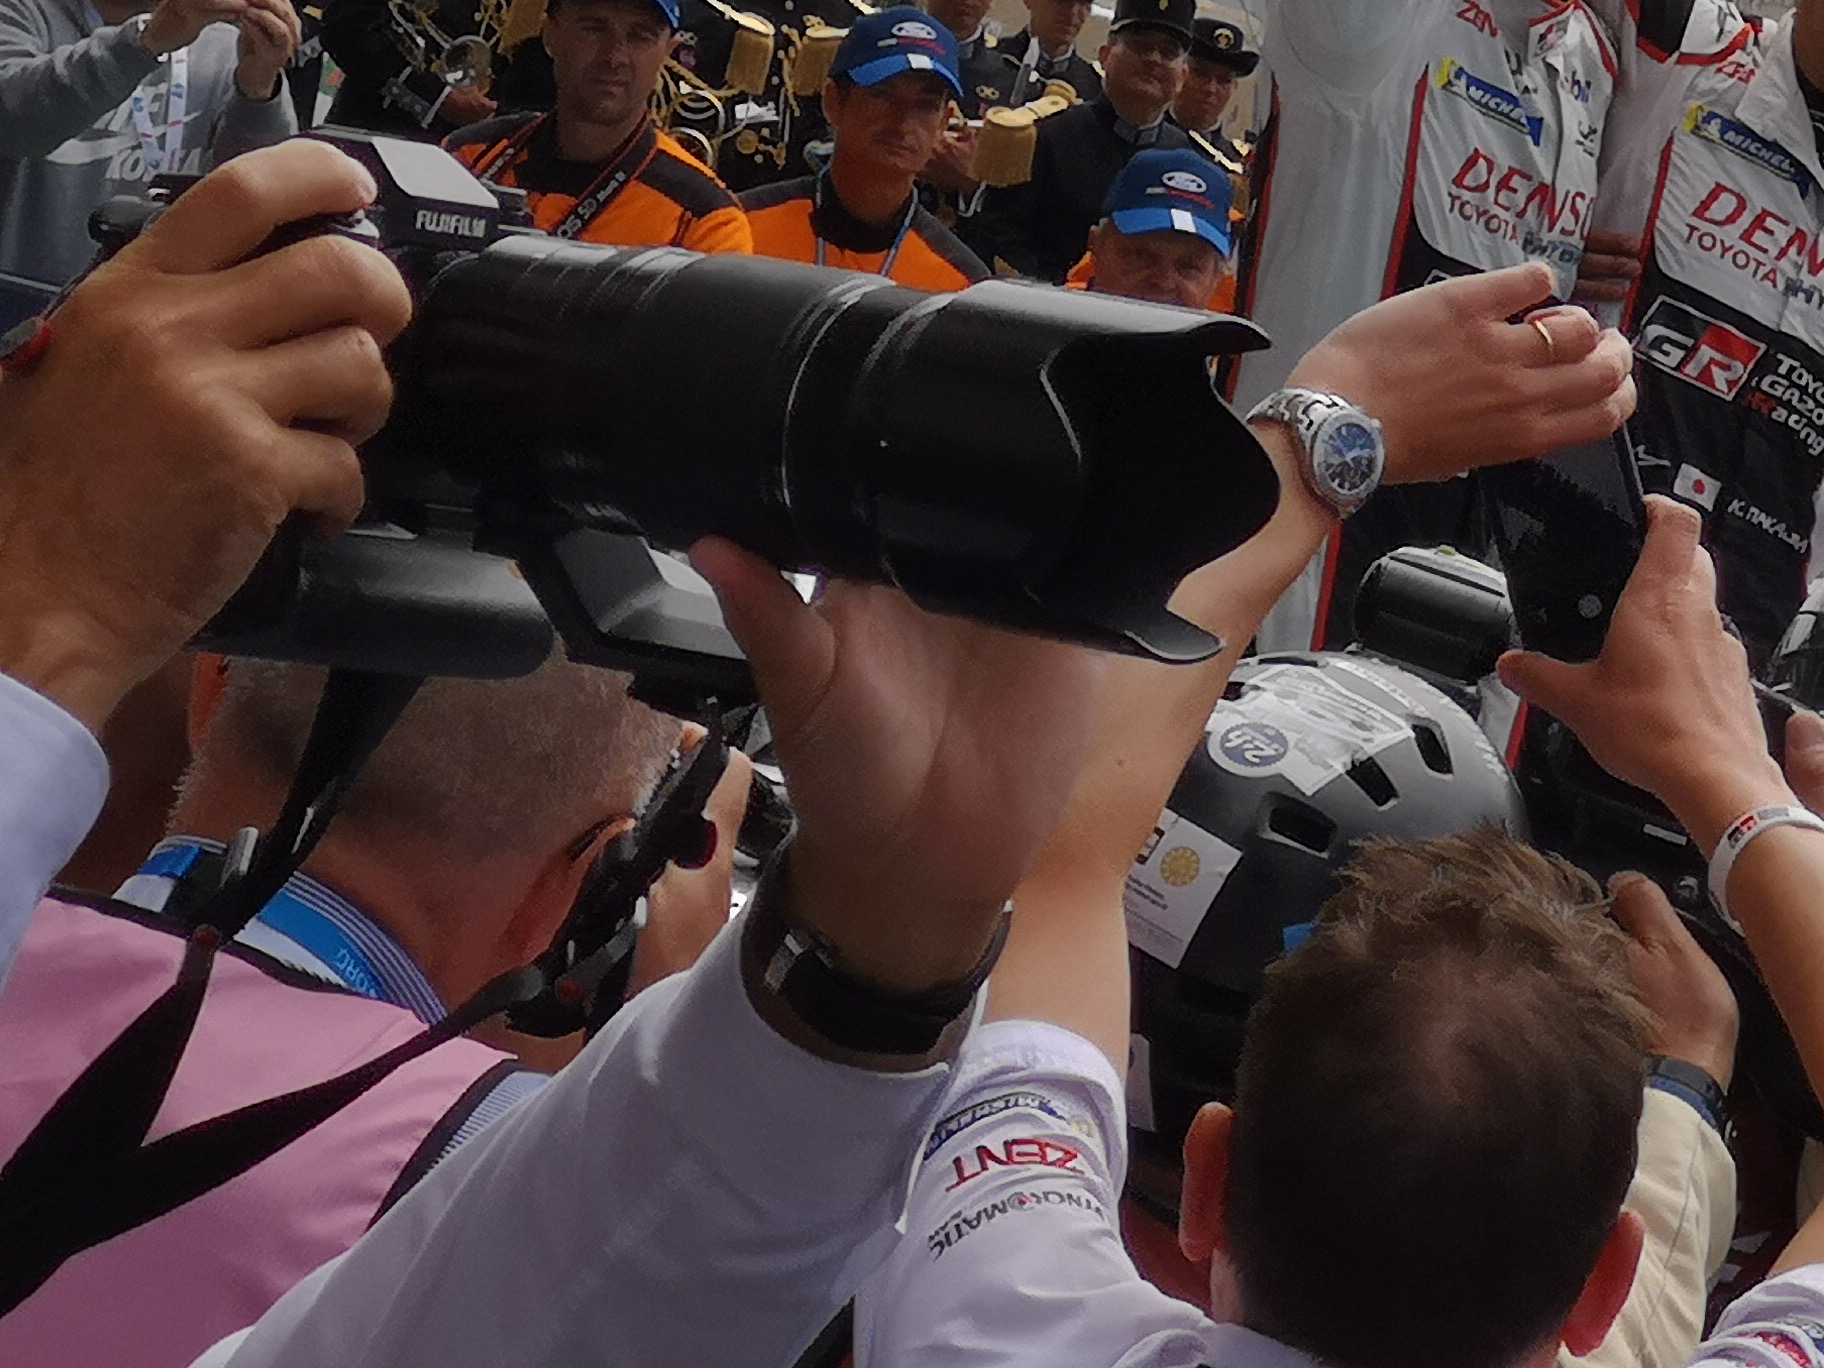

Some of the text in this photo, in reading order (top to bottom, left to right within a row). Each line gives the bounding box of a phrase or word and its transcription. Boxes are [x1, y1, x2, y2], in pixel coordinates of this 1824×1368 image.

[415, 209, 487, 238] FUJIFILM
[1685, 222, 1779, 289] TOYOTA
[1642, 323, 1746, 395] GR
[946, 1138, 1085, 1193] ZENT
